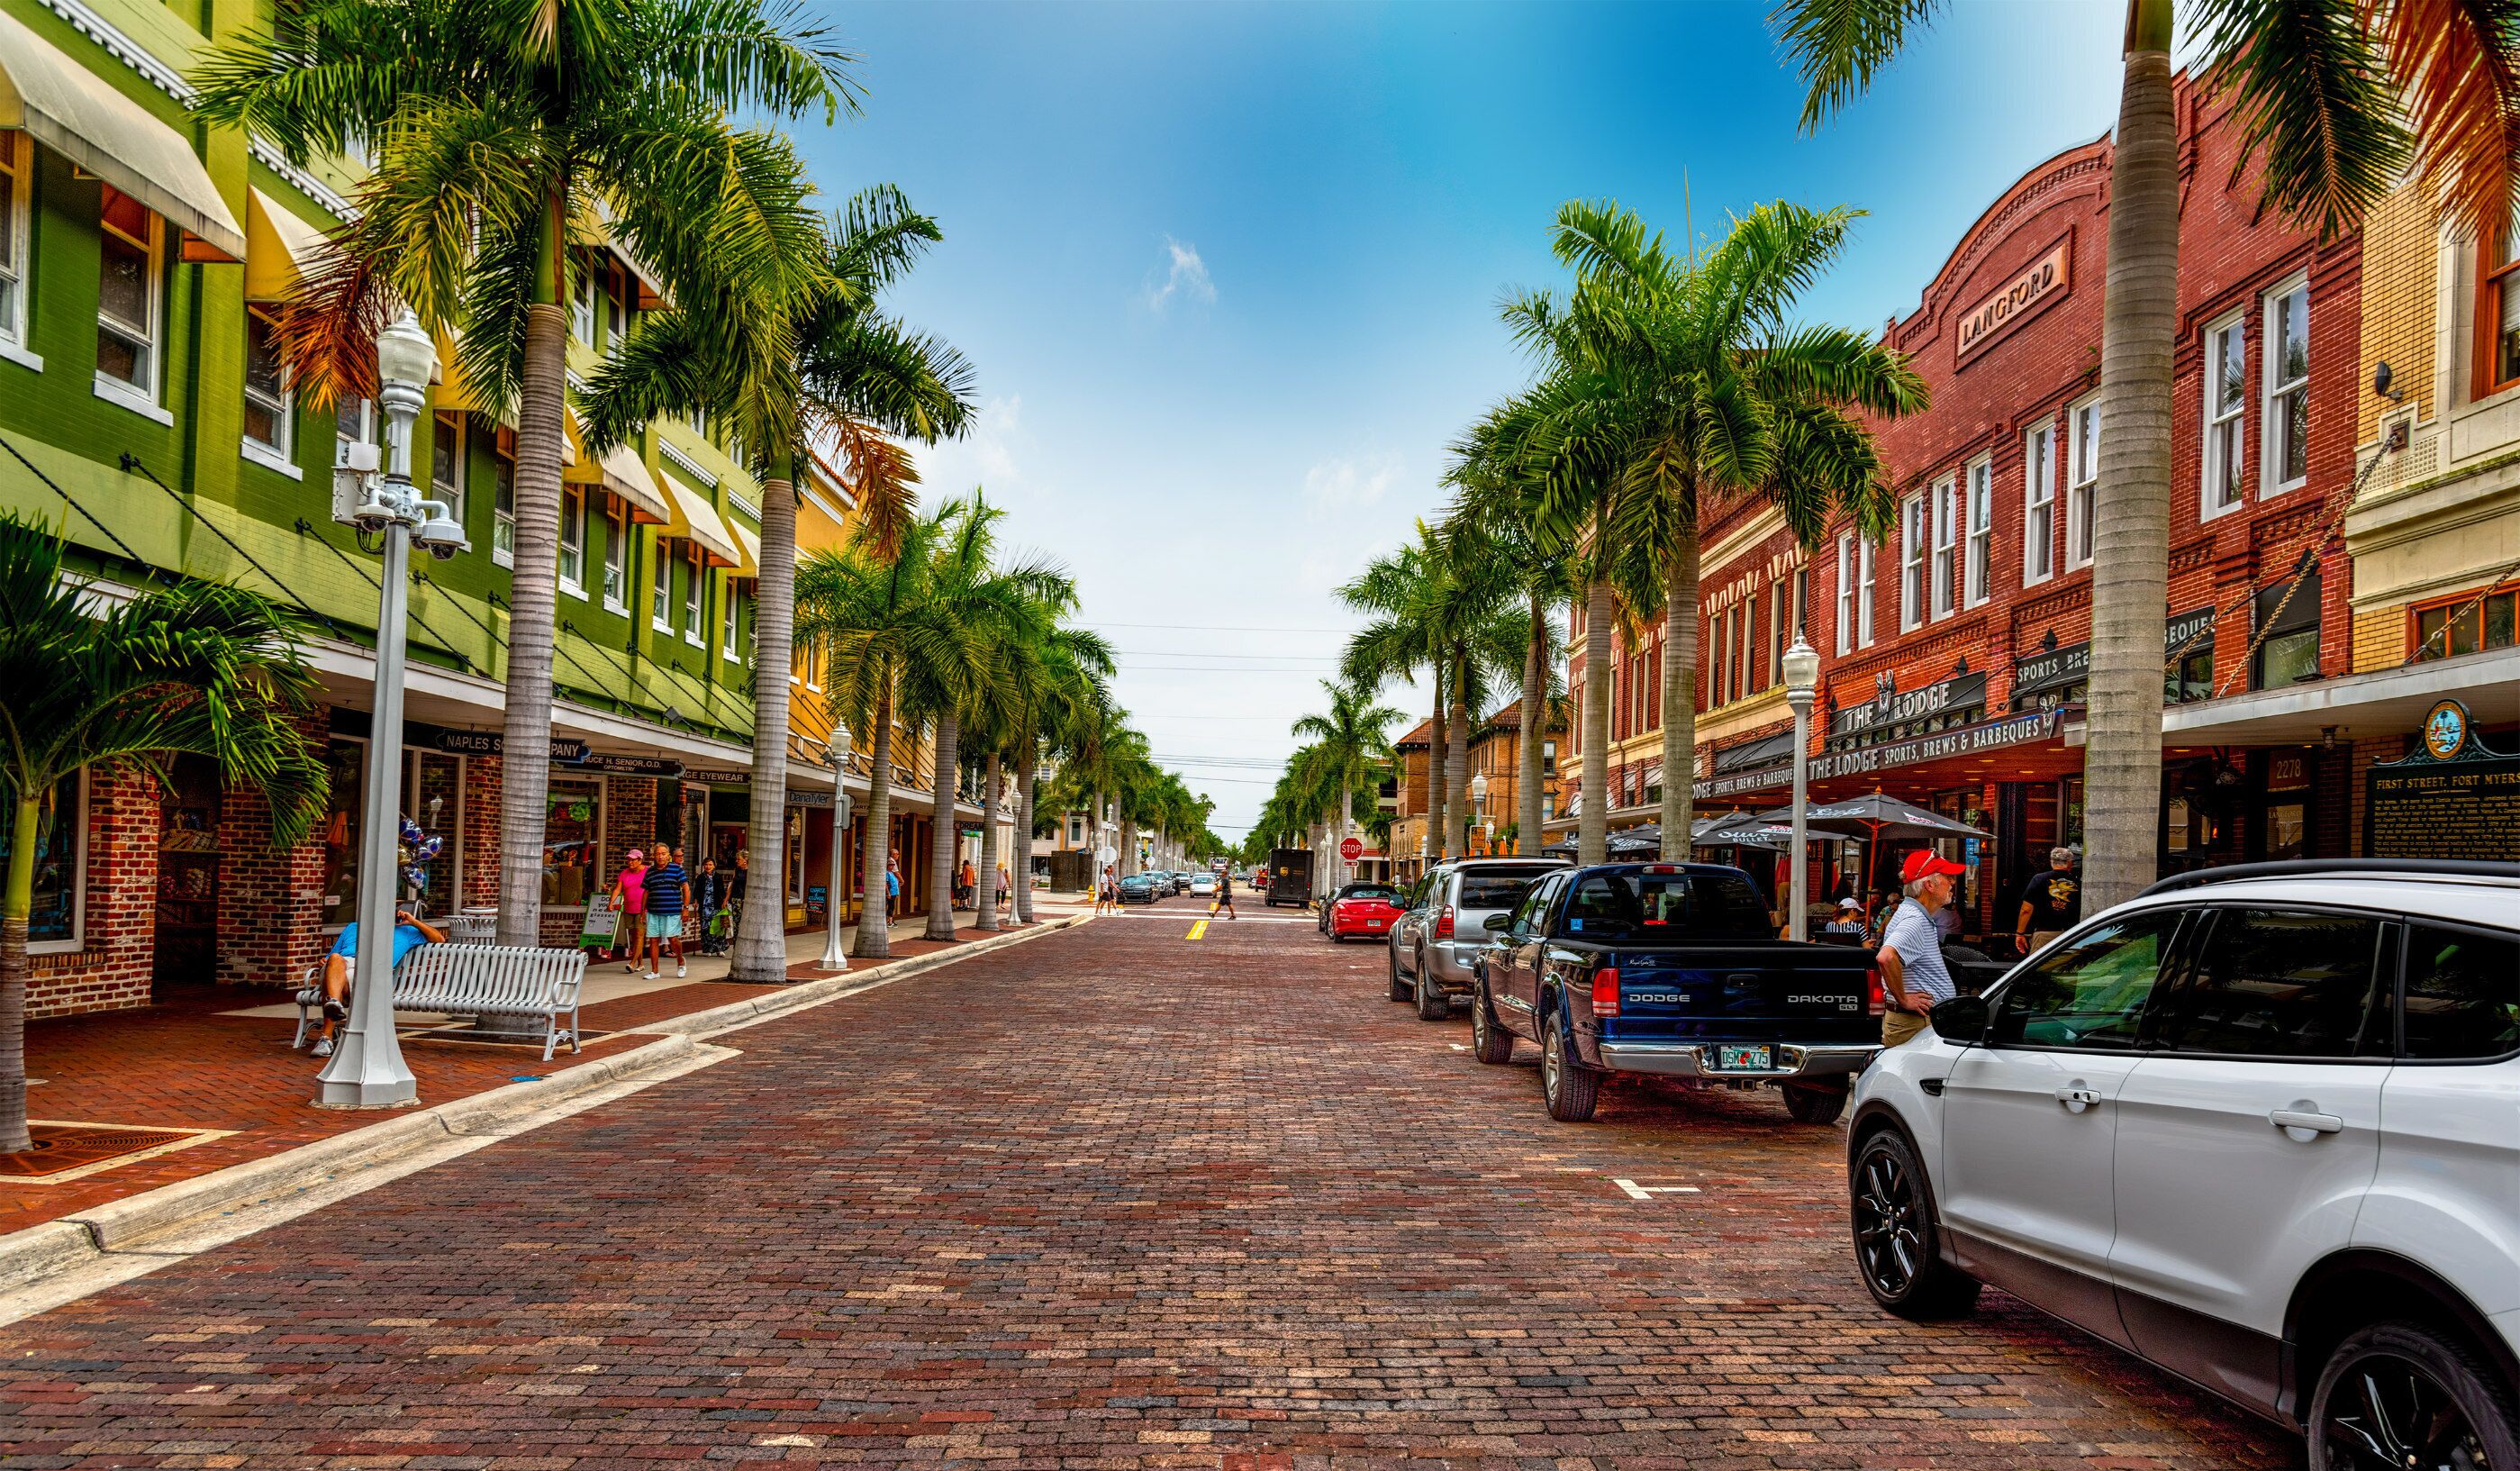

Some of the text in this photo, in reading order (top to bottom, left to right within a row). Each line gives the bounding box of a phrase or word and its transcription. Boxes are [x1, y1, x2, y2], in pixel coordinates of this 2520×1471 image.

[1963, 263, 2053, 346] LANGFORD
[2017, 659, 2061, 683] SPORTS,
[1894, 683, 1951, 720] LODGE
[1845, 705, 1874, 731] THE
[446, 736, 489, 749] NAPLES
[1808, 718, 2039, 780] THE LODGE SPORTS, BREWS & BARBEQUES
[2277, 758, 2301, 779] 2278
[699, 772, 744, 782] EYEWEAR
[1736, 776, 1754, 790] BREWS
[2377, 779, 2403, 789] FIRST
[2452, 775, 2479, 785] FORT
[2484, 773, 2520, 784] MYERS
[1342, 844, 1361, 854] STOP
[1629, 994, 1691, 1003] DODGE
[1788, 995, 1858, 1003] DAKOTA
